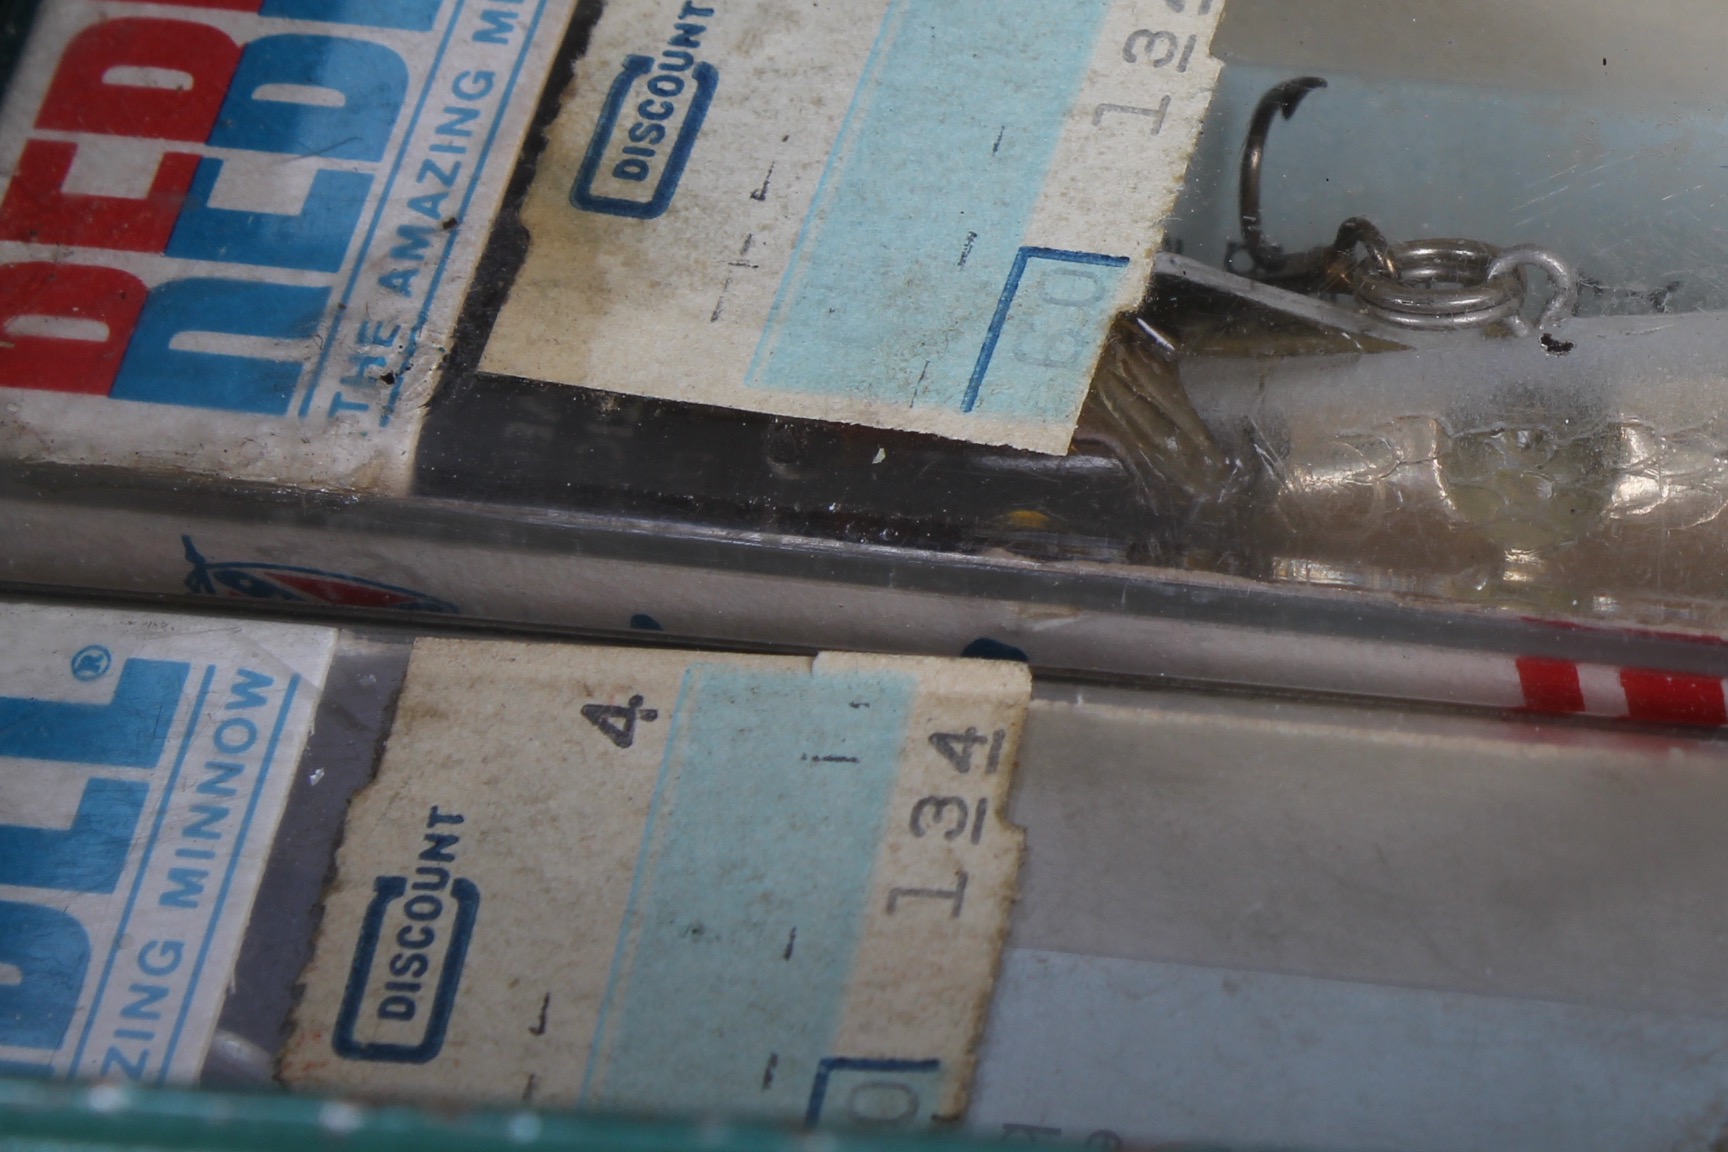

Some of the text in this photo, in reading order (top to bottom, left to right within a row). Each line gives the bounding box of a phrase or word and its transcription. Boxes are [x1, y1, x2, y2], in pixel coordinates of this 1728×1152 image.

[329, 320, 404, 419] THE
[386, 68, 496, 297] AMAZING
[160, 666, 276, 911] MINNOW
[580, 693, 659, 750] 4
[377, 803, 466, 1022] DISCOUNT
